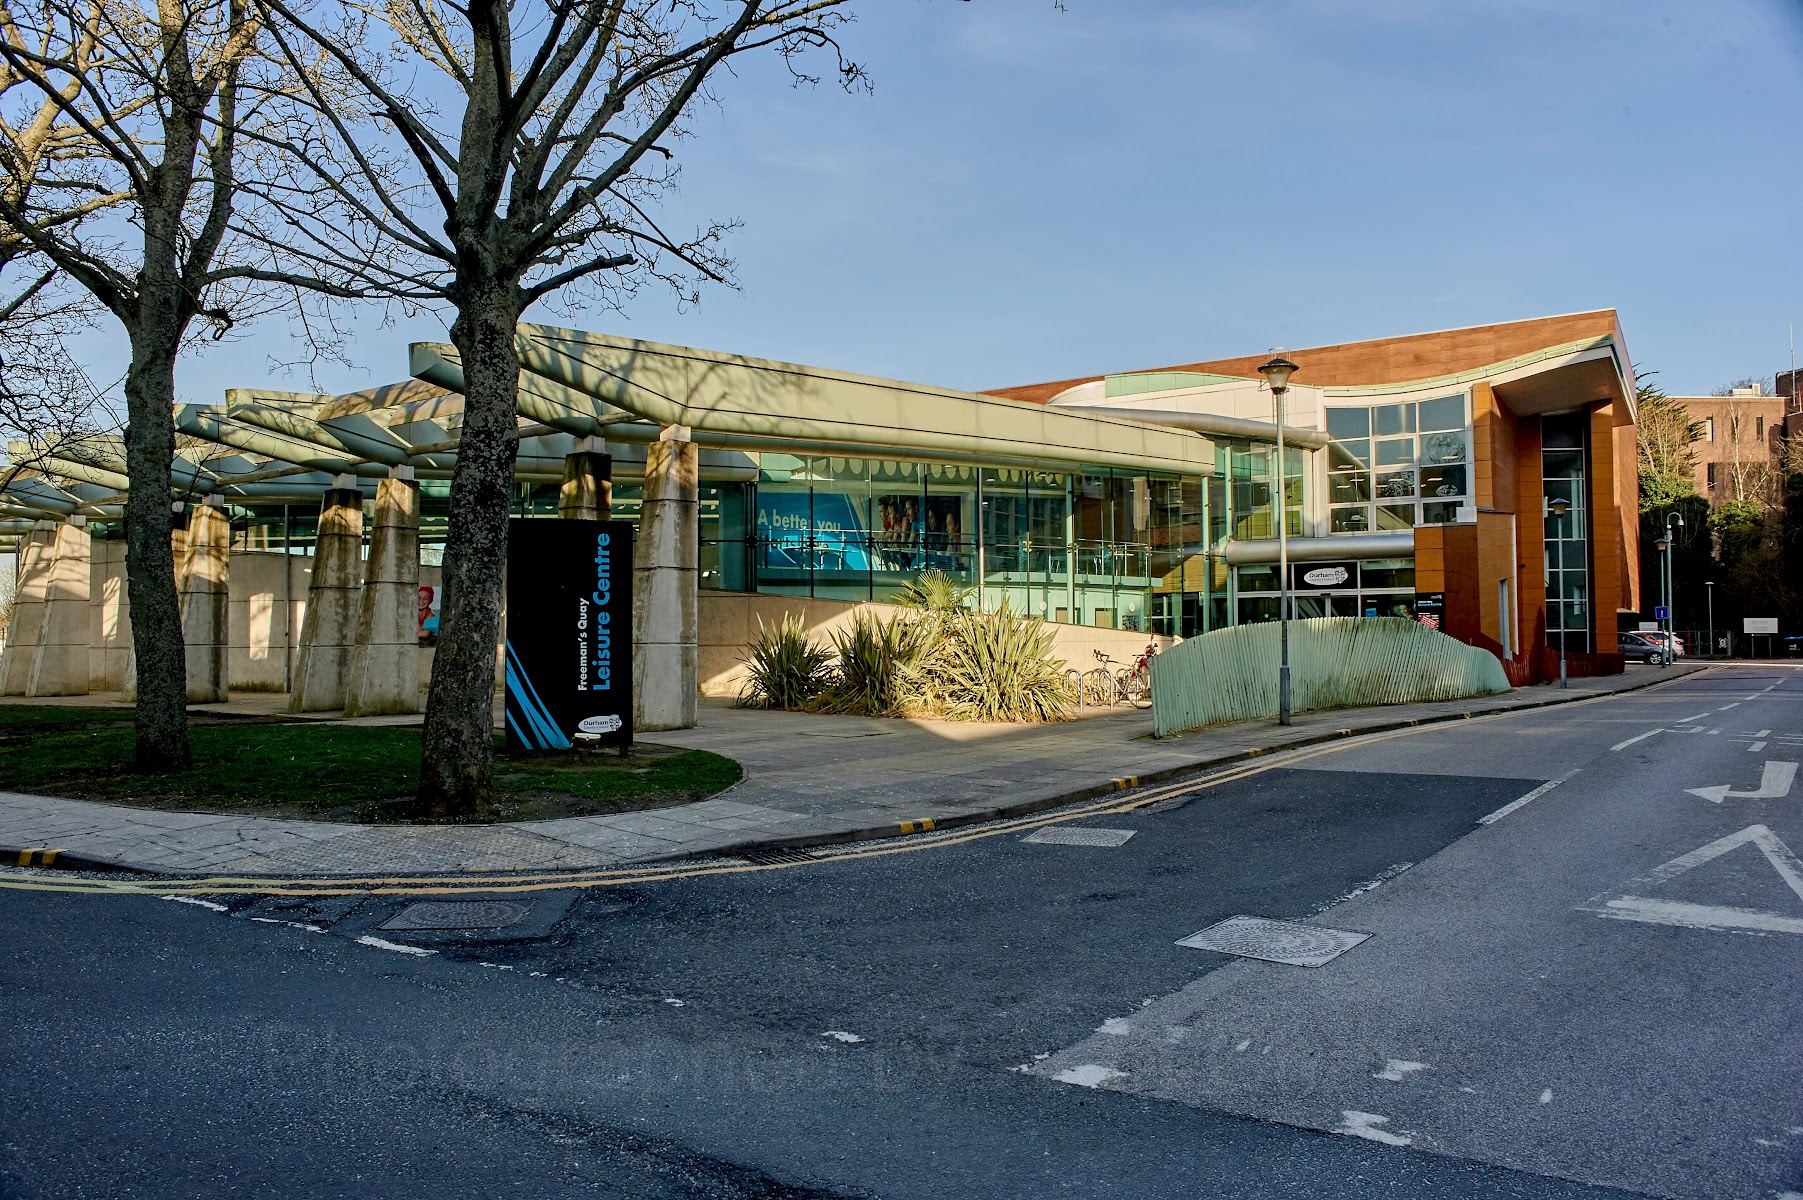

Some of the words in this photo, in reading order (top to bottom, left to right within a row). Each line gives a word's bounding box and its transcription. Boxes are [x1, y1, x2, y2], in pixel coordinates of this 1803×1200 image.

[758, 509, 768, 526] A
[817, 520, 841, 536] you
[592, 533, 611, 605] Centre
[577, 598, 590, 629] Quay
[577, 631, 588, 691] Freeman's
[592, 612, 611, 690] Leisure
